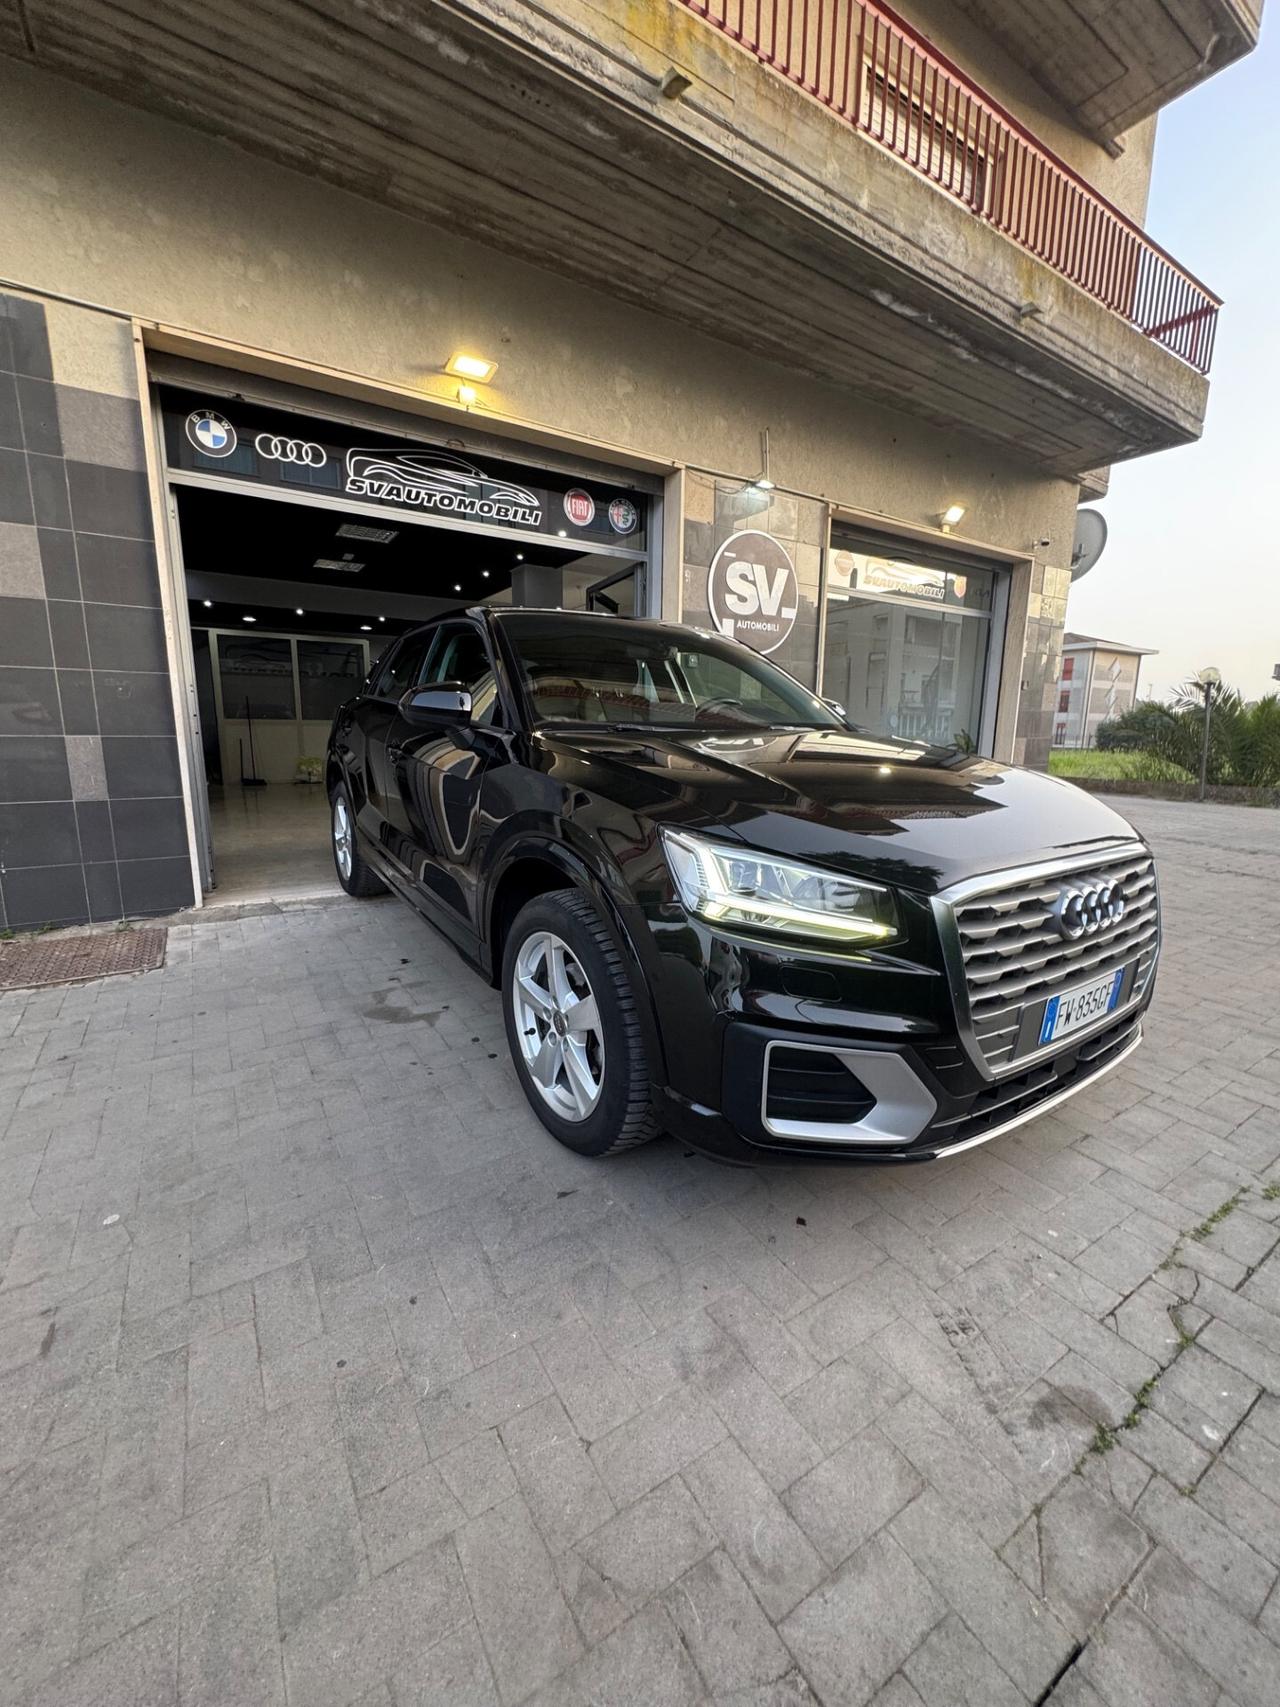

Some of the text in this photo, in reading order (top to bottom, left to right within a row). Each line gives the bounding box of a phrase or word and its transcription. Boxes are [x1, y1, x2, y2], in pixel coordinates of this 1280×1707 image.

[191, 412, 231, 430] BMW
[346, 477, 541, 526] SVAUTOMOBILI
[571, 498, 589, 516] FIAT
[737, 620, 780, 632] AUTOMOBILI
